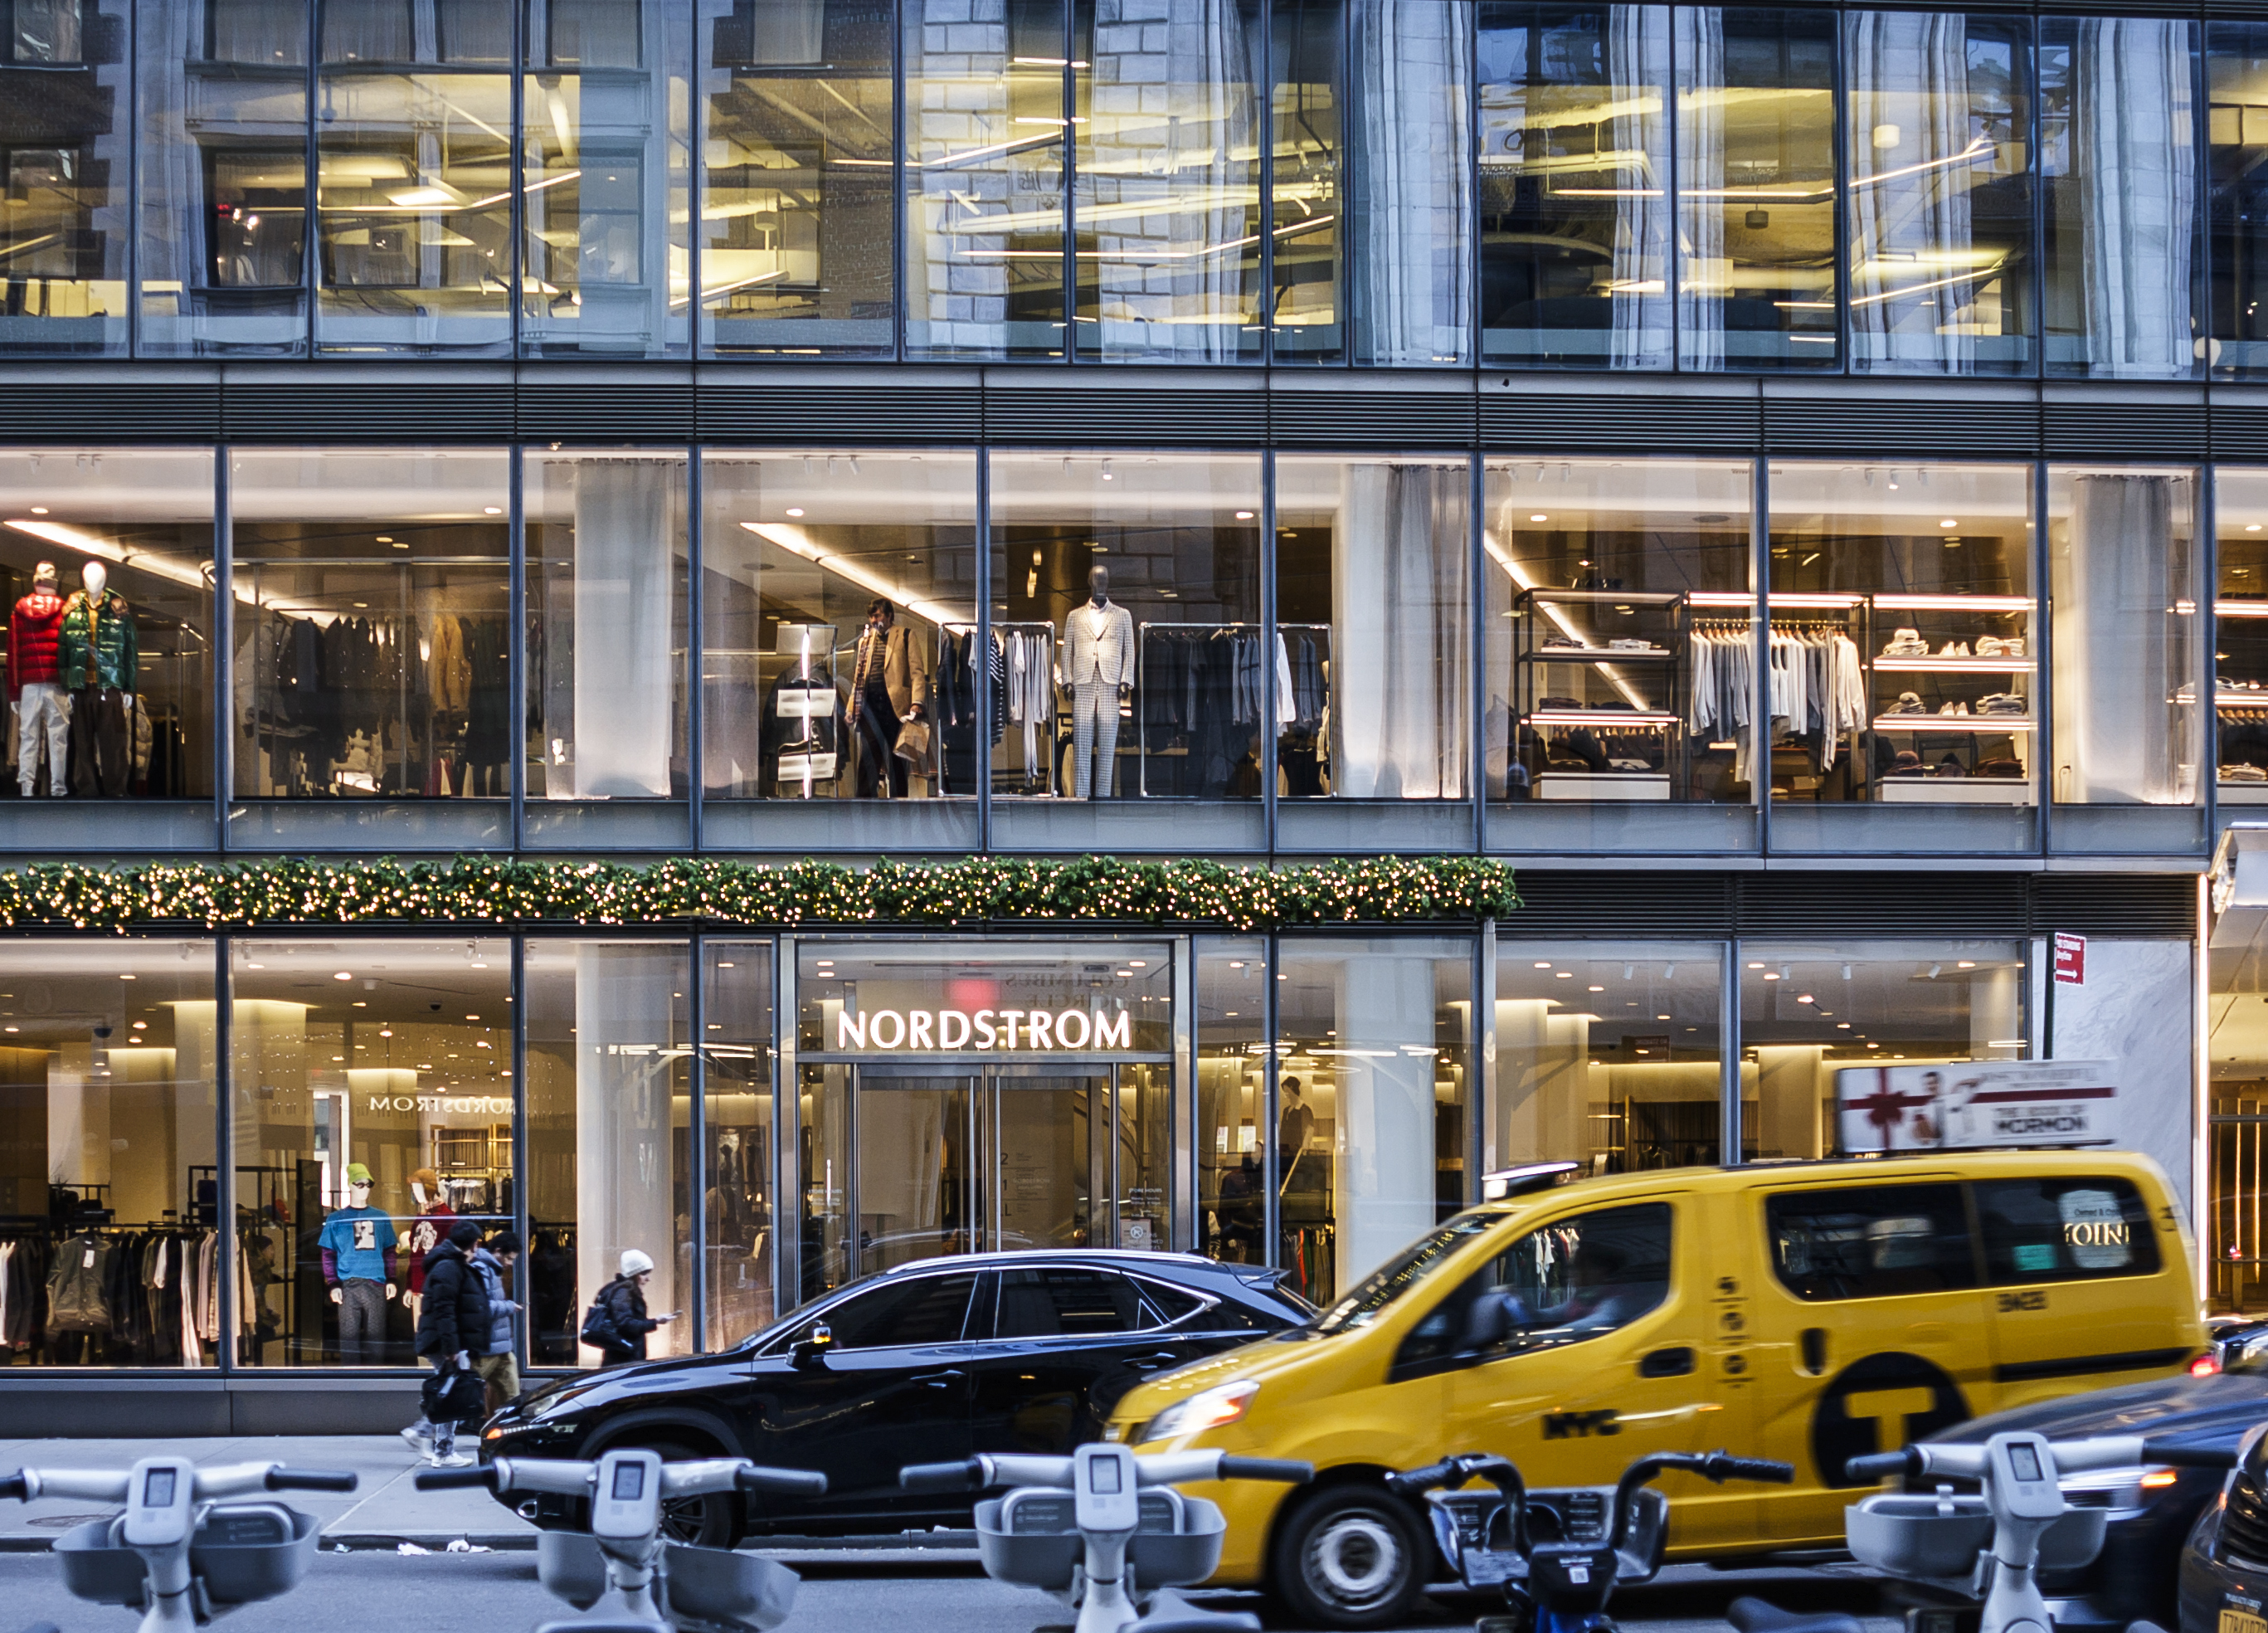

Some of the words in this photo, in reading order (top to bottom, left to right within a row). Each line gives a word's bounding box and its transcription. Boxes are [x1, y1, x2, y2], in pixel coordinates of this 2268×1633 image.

[838, 1010, 1131, 1049] NORDSTROM
[1000, 1153, 1008, 1165] 2
[1542, 1409, 1623, 1440] NYC
[1846, 1387, 1934, 1467] T
